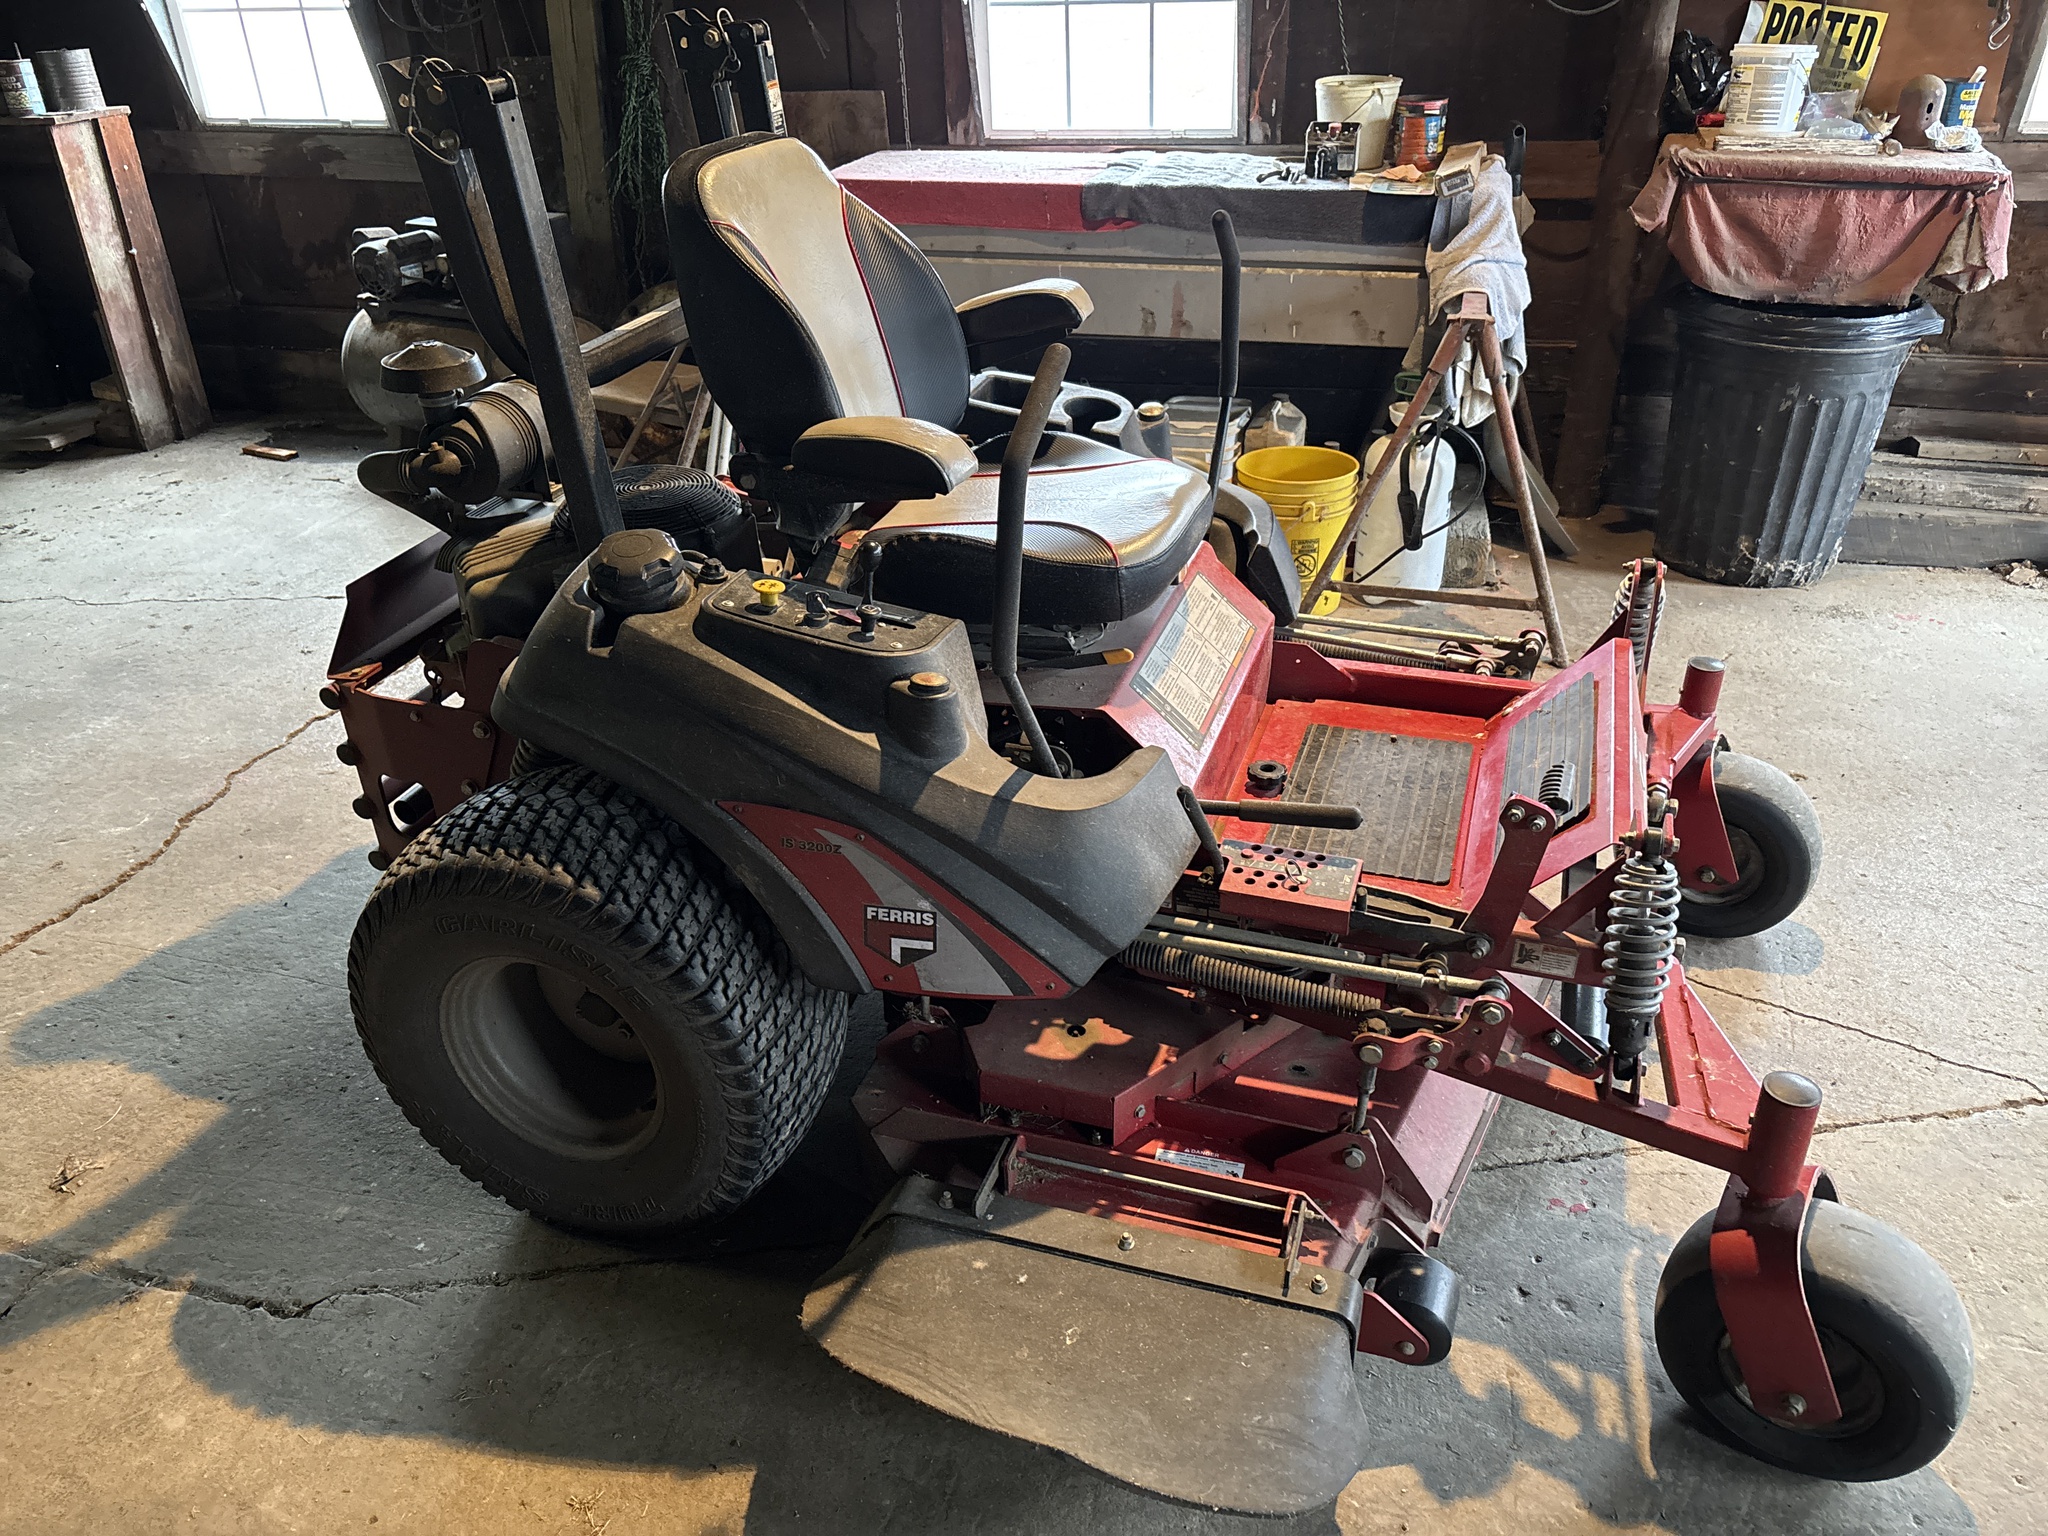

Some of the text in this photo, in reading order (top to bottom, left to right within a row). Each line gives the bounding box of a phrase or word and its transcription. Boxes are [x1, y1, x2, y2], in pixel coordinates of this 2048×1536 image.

[1762, 3, 1878, 71] POSTED
[781, 837, 842, 854] IS 3200Z
[866, 906, 935, 926] FERRIS
[434, 912, 653, 1012] CARLISLE
[1191, 1148, 1220, 1158] DANGER
